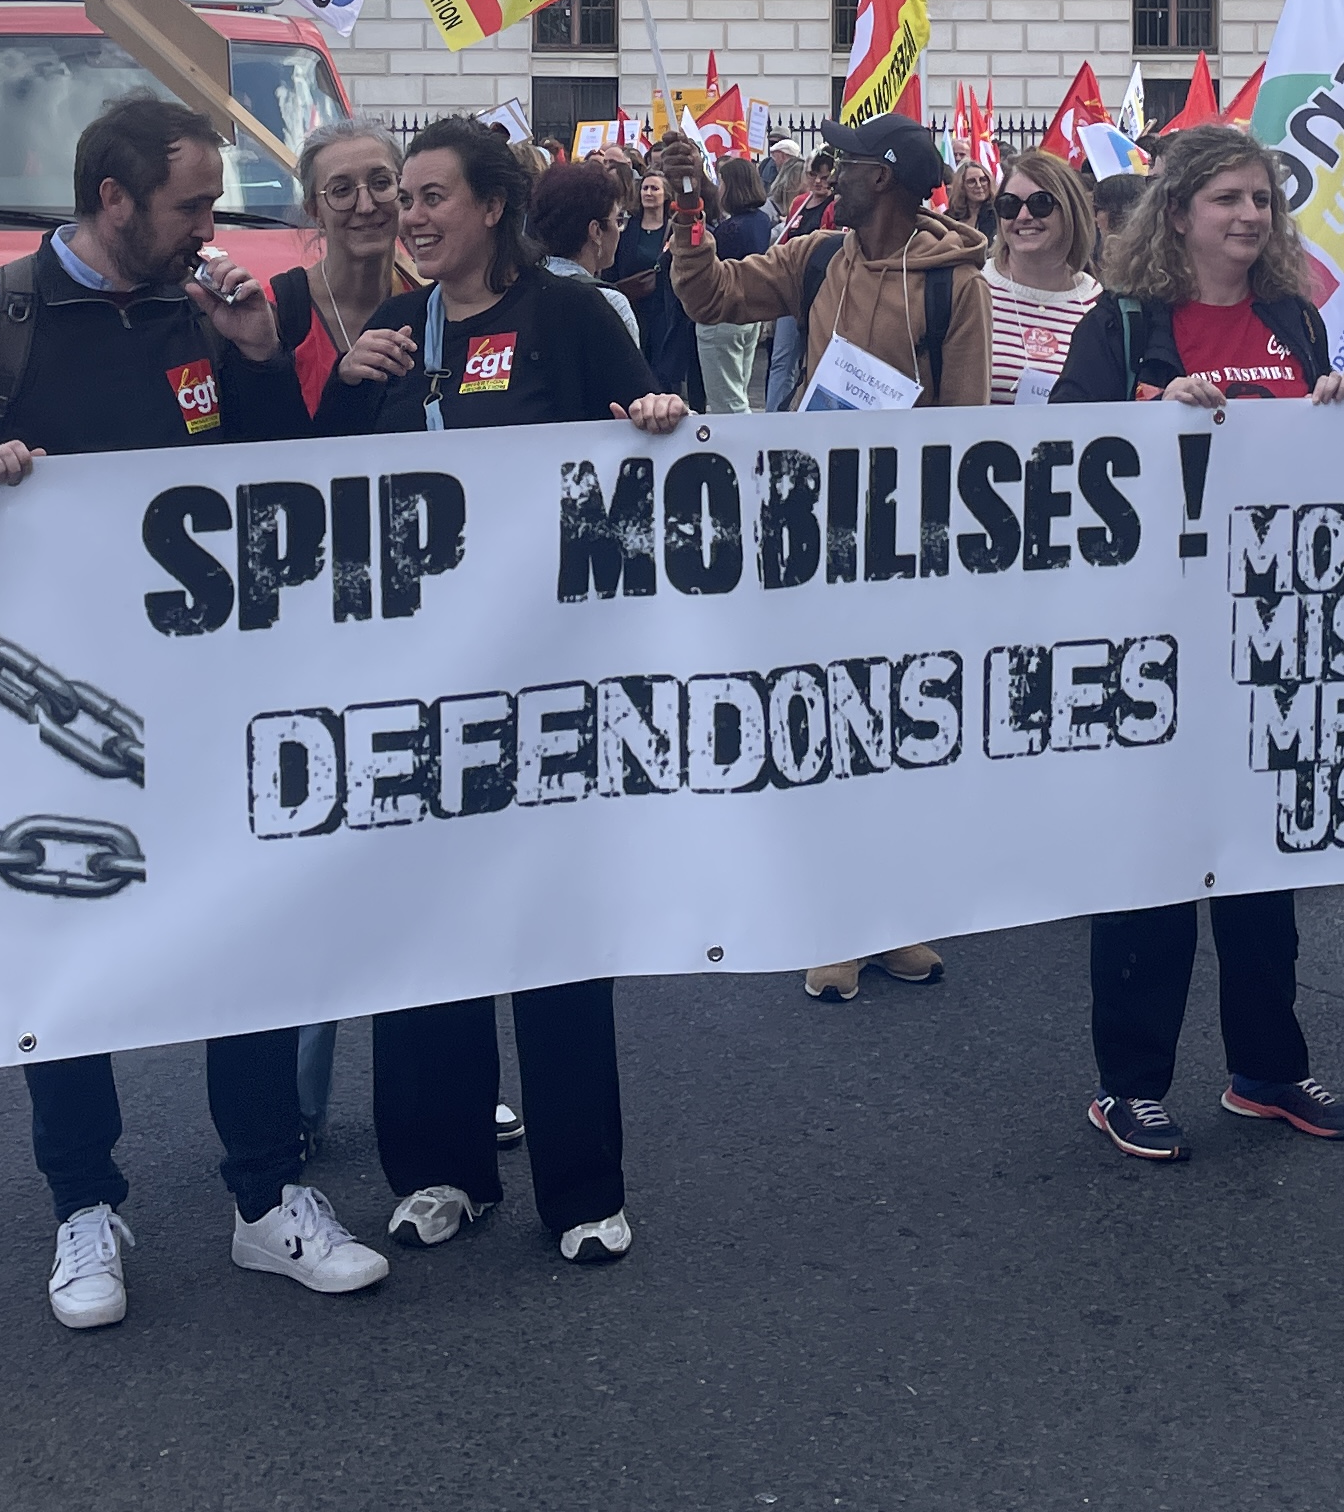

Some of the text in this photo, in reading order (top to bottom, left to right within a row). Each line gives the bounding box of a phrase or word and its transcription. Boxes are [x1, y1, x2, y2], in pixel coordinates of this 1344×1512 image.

[466, 346, 514, 379] cgt
[834, 356, 905, 402] LUDIQUEMENT
[1223, 366, 1296, 381] ENSEMBLE
[177, 374, 219, 414] cgt
[845, 381, 877, 406] VOTRE
[142, 471, 466, 637] SPIP
[557, 436, 1141, 603] MOBILISES
[247, 634, 1179, 840] DEFENDONS LES
